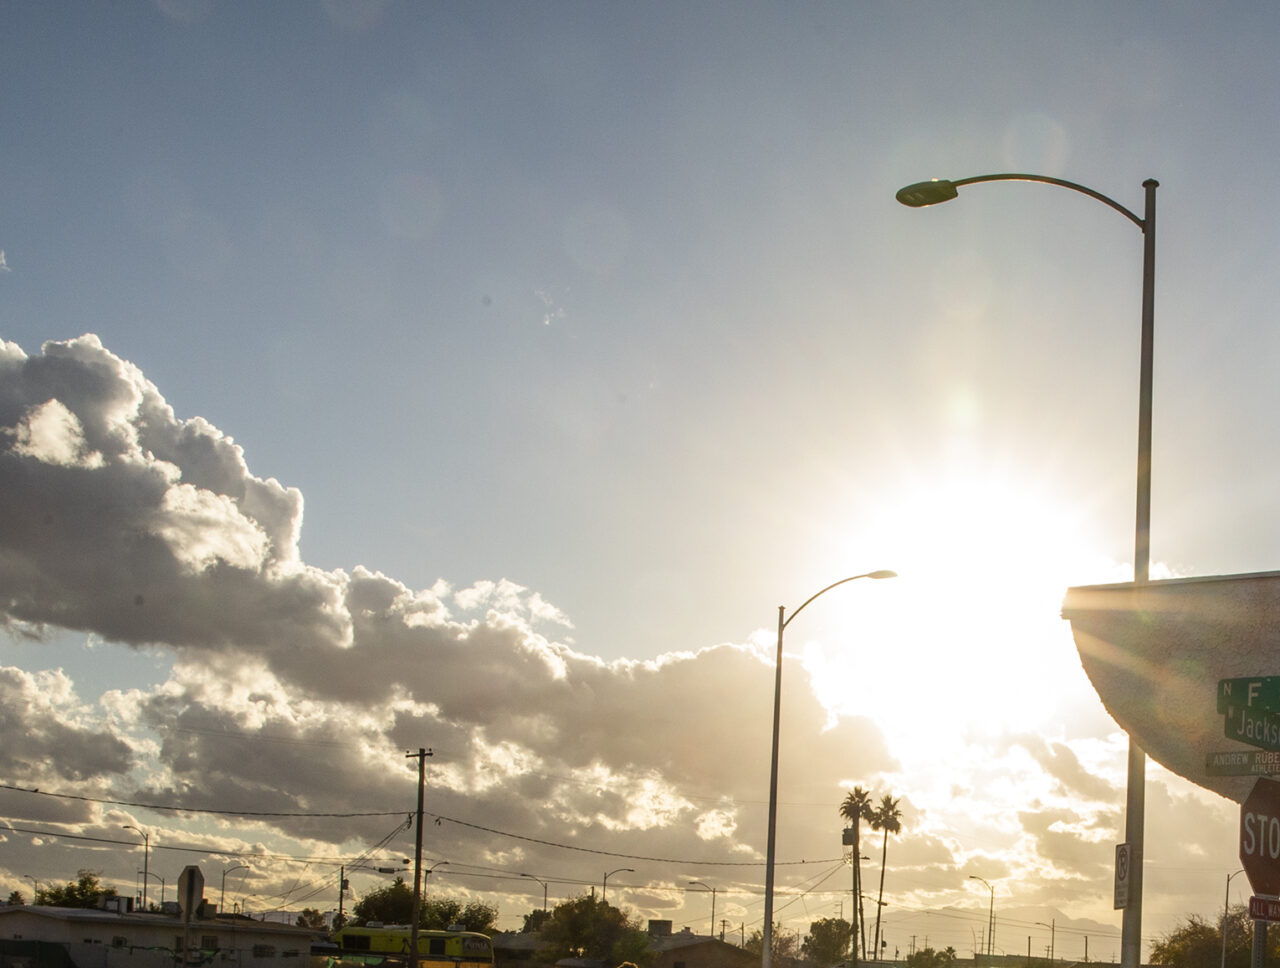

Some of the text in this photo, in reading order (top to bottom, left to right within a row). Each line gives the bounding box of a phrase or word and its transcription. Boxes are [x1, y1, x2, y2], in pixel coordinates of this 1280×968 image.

[1223, 682, 1232, 697] N
[1247, 682, 1262, 707] F
[1213, 753, 1249, 766] ANDREW
[1255, 752, 1280, 764] RUBE
[1251, 763, 1280, 773] ATHLETE
[1251, 901, 1265, 916] ALL
